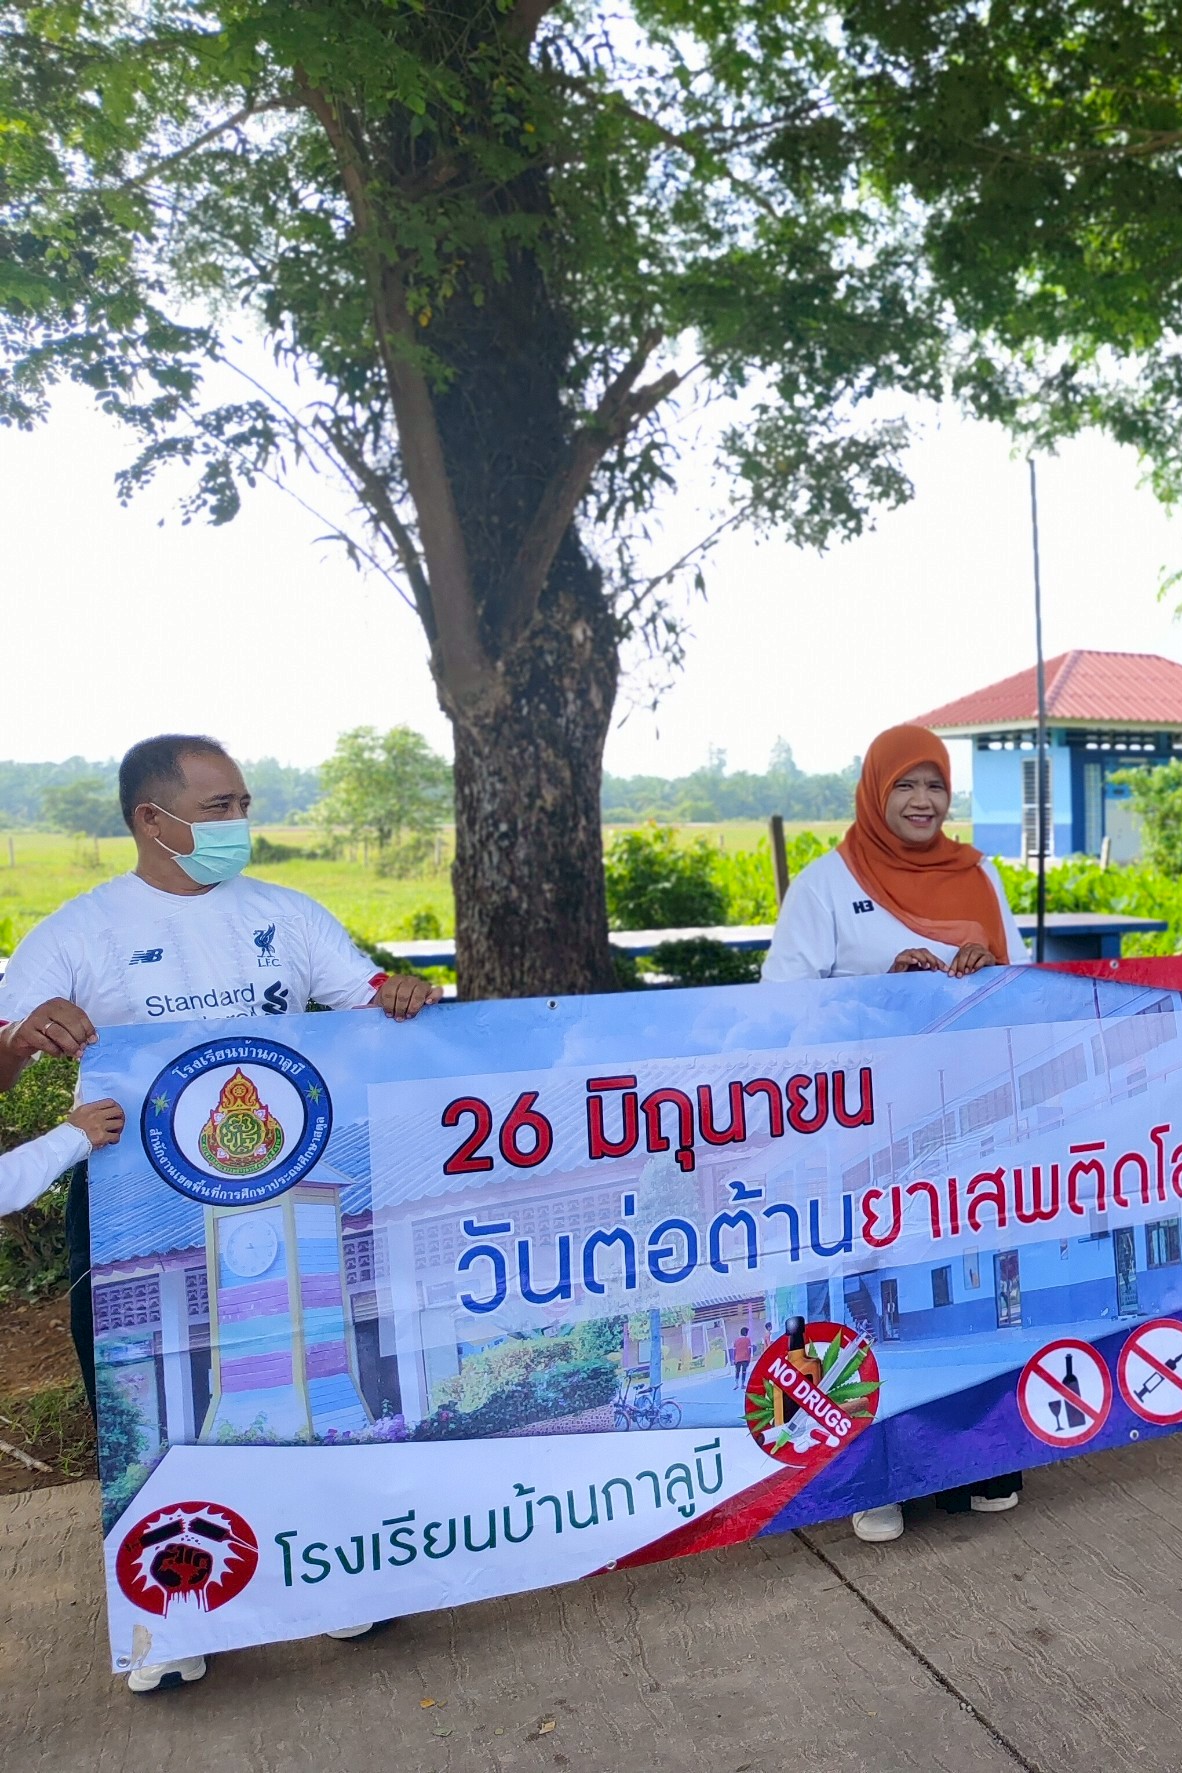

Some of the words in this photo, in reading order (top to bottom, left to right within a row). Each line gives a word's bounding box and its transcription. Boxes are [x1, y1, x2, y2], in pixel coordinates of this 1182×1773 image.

[145, 982, 256, 1017] Standard
[172, 1040, 306, 1079] โรงเรียนบ้านกาลูบี
[441, 1090, 553, 1175] 26
[585, 1066, 875, 1172] มิถุนายน
[767, 1357, 797, 1387] NO
[792, 1380, 852, 1437] DRUGS
[274, 1437, 725, 1587] โรงเรียนบ้านกาลูบี
